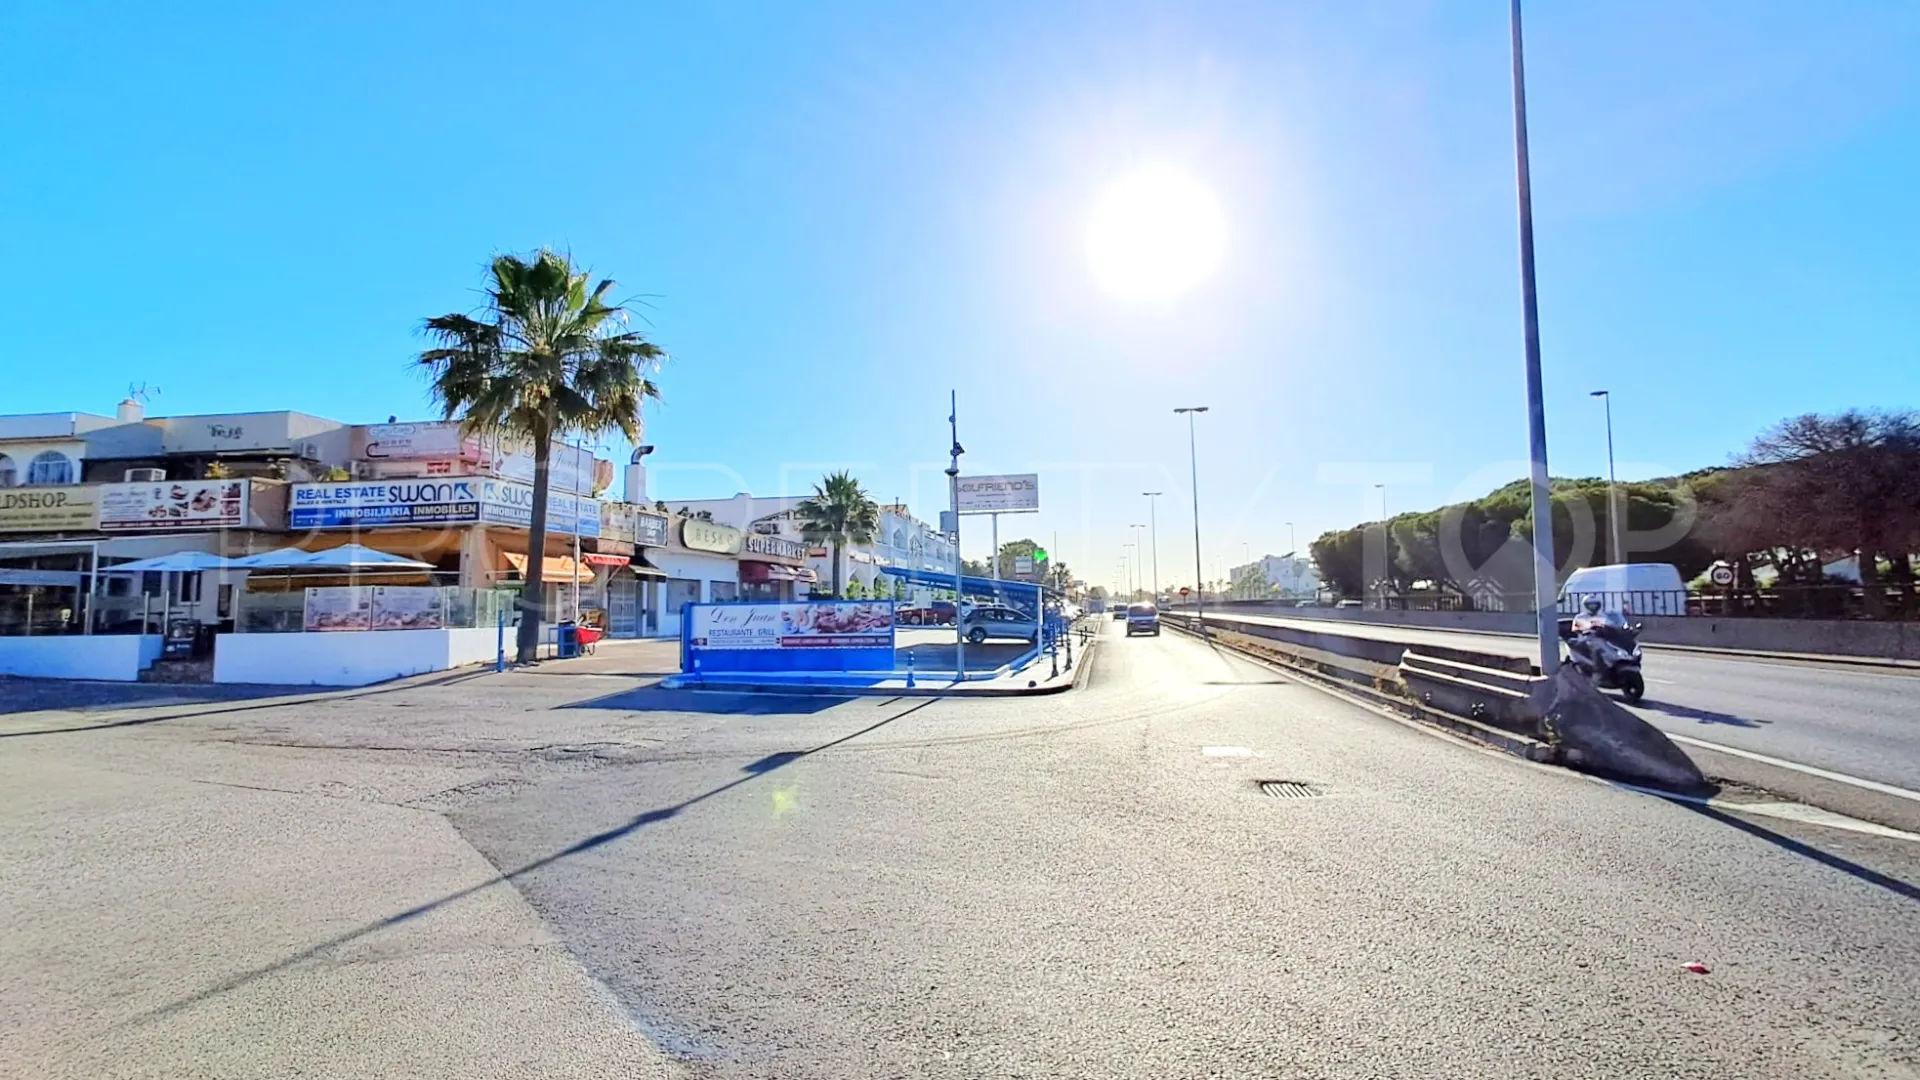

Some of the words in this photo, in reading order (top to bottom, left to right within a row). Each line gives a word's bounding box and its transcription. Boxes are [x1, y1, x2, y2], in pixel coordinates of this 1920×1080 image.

[296, 488, 331, 500] REAL
[335, 486, 385, 499] ESTATE
[335, 506, 411, 519] INMOBILIARIA
[413, 503, 477, 515] INMOBILIEN
[569, 499, 598, 515] ETATE
[747, 538, 805, 560] SUPERMARKET
[709, 628, 753, 637] RESTAURANTE
[758, 628, 776, 636] GRILL
